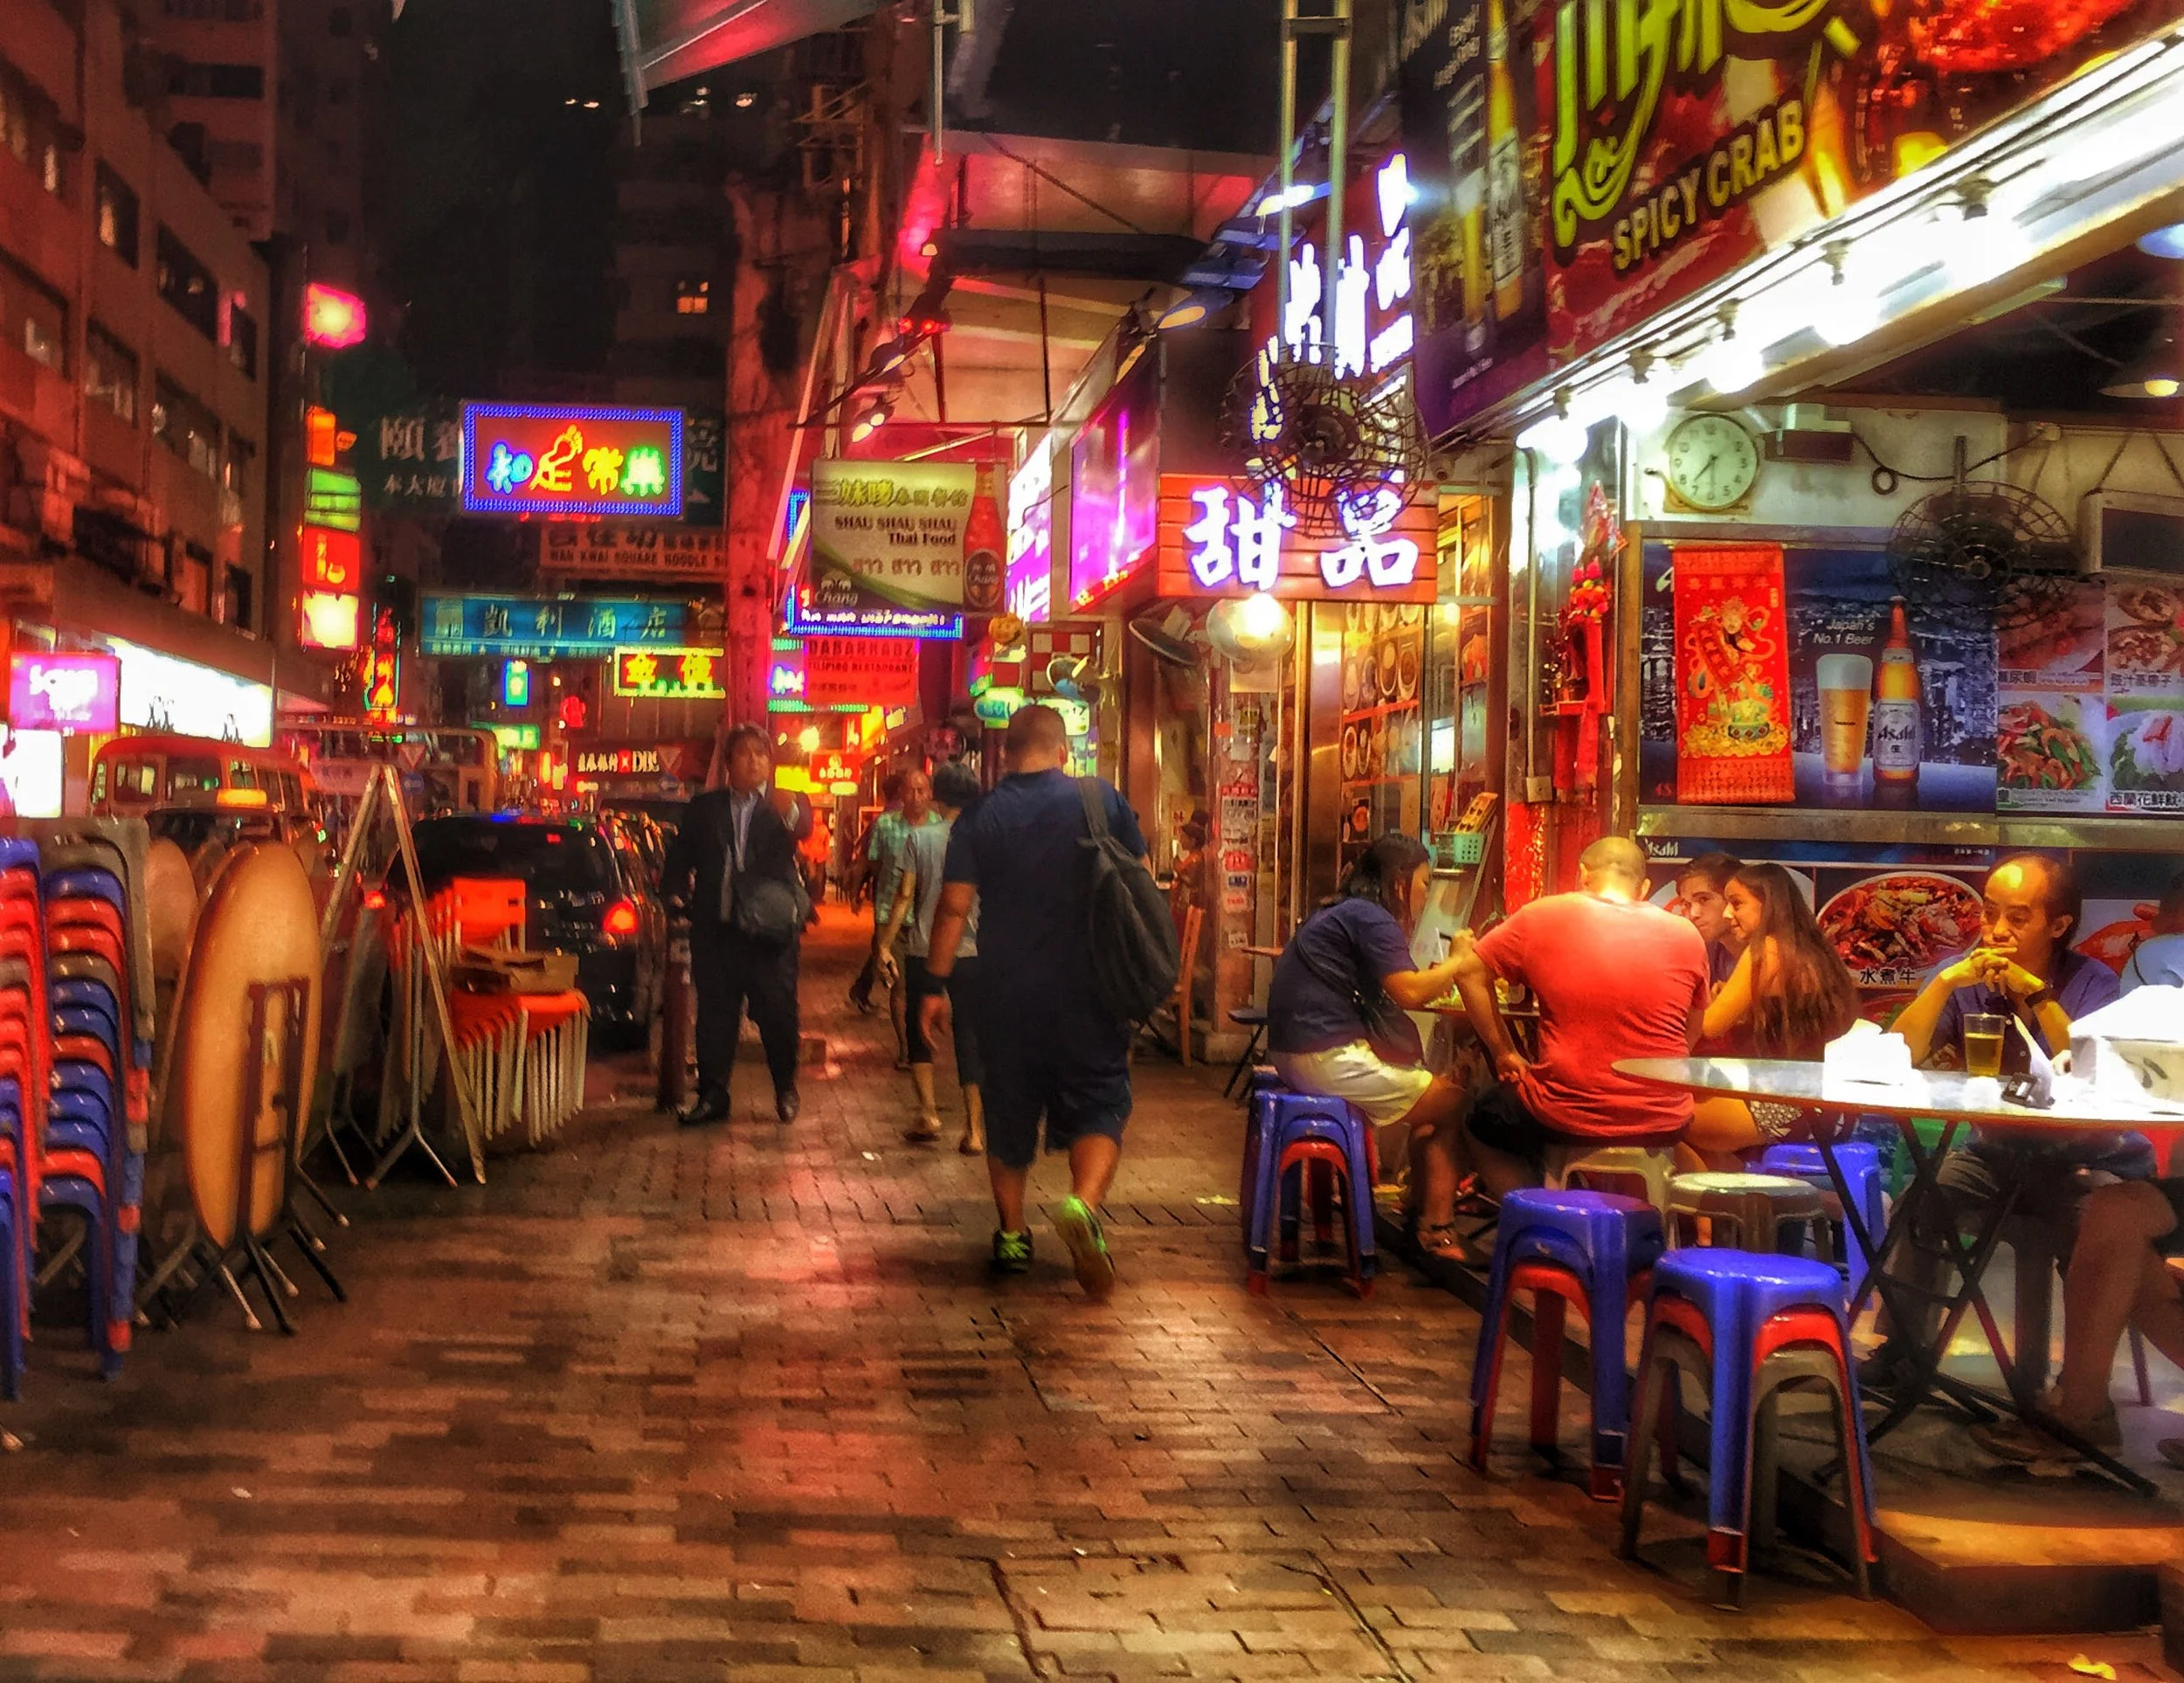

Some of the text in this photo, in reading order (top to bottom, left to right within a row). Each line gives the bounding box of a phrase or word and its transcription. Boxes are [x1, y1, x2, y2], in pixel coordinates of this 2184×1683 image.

[1613, 167, 1700, 270] SPICY
[1707, 99, 1804, 207] CRAB
[888, 532, 957, 545] Thai Food
[1184, 482, 1419, 591] 甜品
[814, 590, 859, 606] Chang
[1826, 619, 1876, 632] Japan's
[1845, 633, 1876, 645] Beer
[1878, 724, 1917, 741] Asahi
